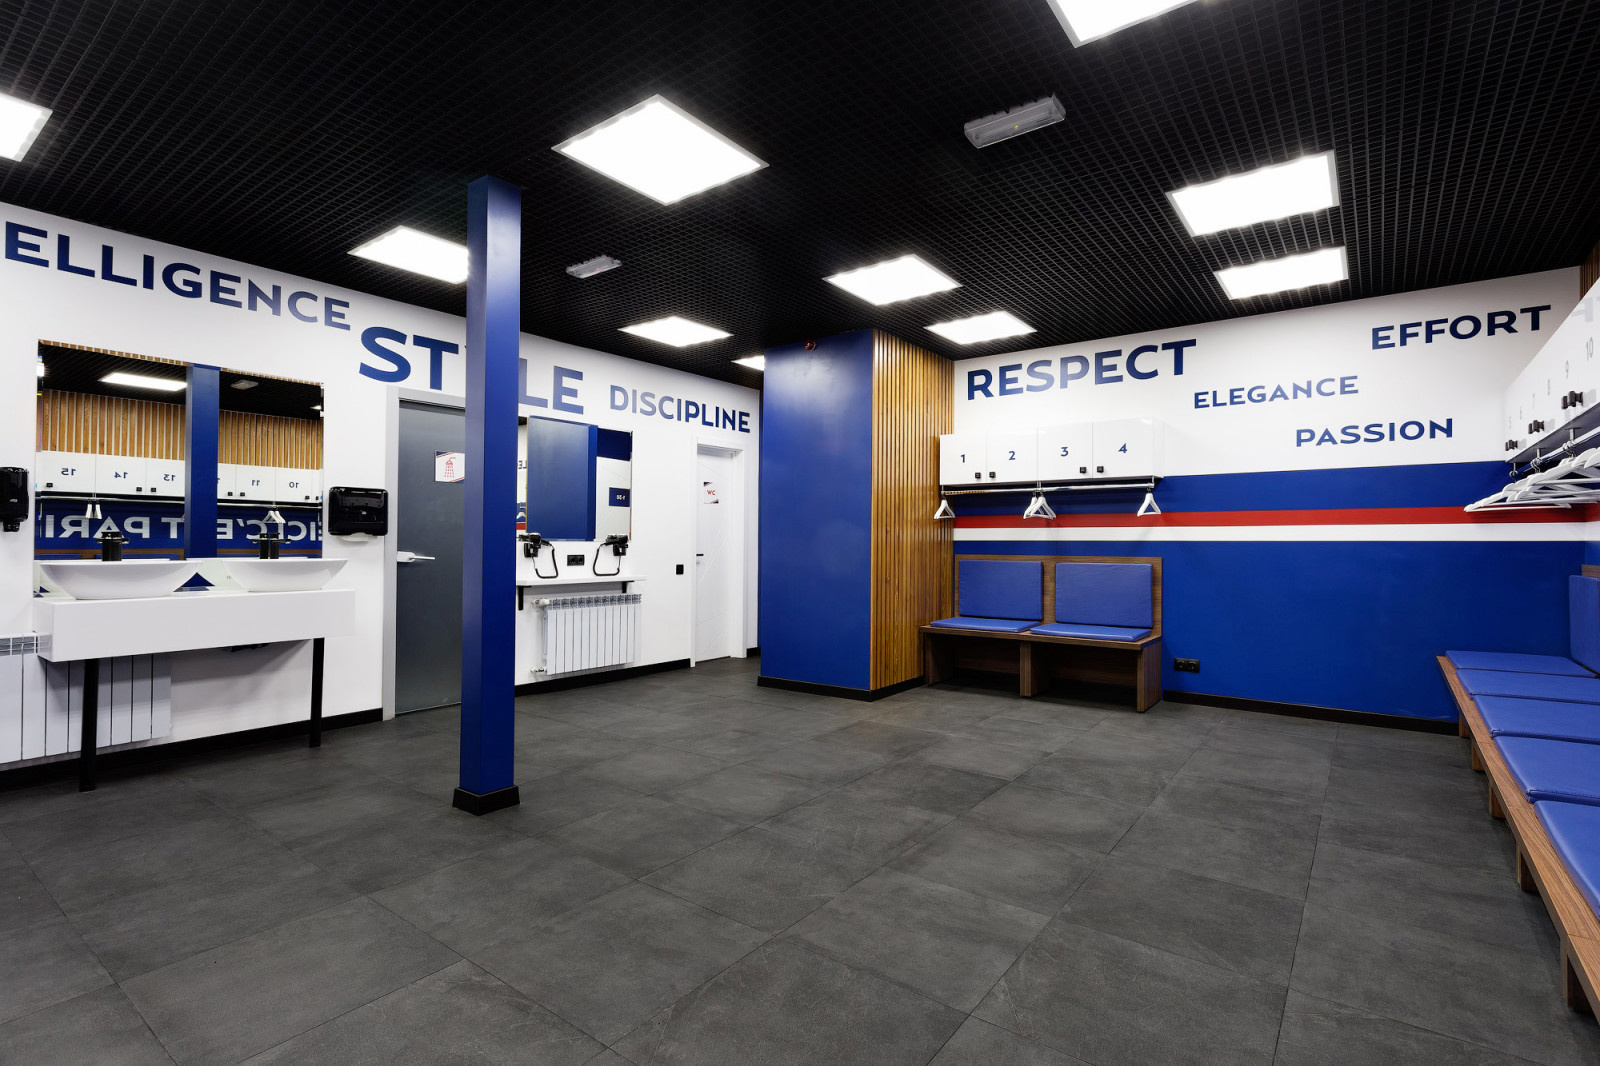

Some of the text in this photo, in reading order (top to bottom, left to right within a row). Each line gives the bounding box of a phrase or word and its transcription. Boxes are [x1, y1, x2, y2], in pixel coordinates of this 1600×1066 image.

[5, 220, 351, 331] ELLIGENCE
[1371, 304, 1551, 350] EFFORT
[1585, 336, 1594, 361] 10
[359, 325, 584, 415] STLE
[967, 338, 1197, 401] RESPECT
[1193, 375, 1360, 409] ELEGANCE
[610, 384, 751, 434] DISCIPLINE
[1118, 443, 1128, 454] 4
[1296, 418, 1454, 448] PASSION
[960, 454, 966, 463] 1
[1008, 450, 1016, 461] 2
[1061, 446, 1069, 457] 3
